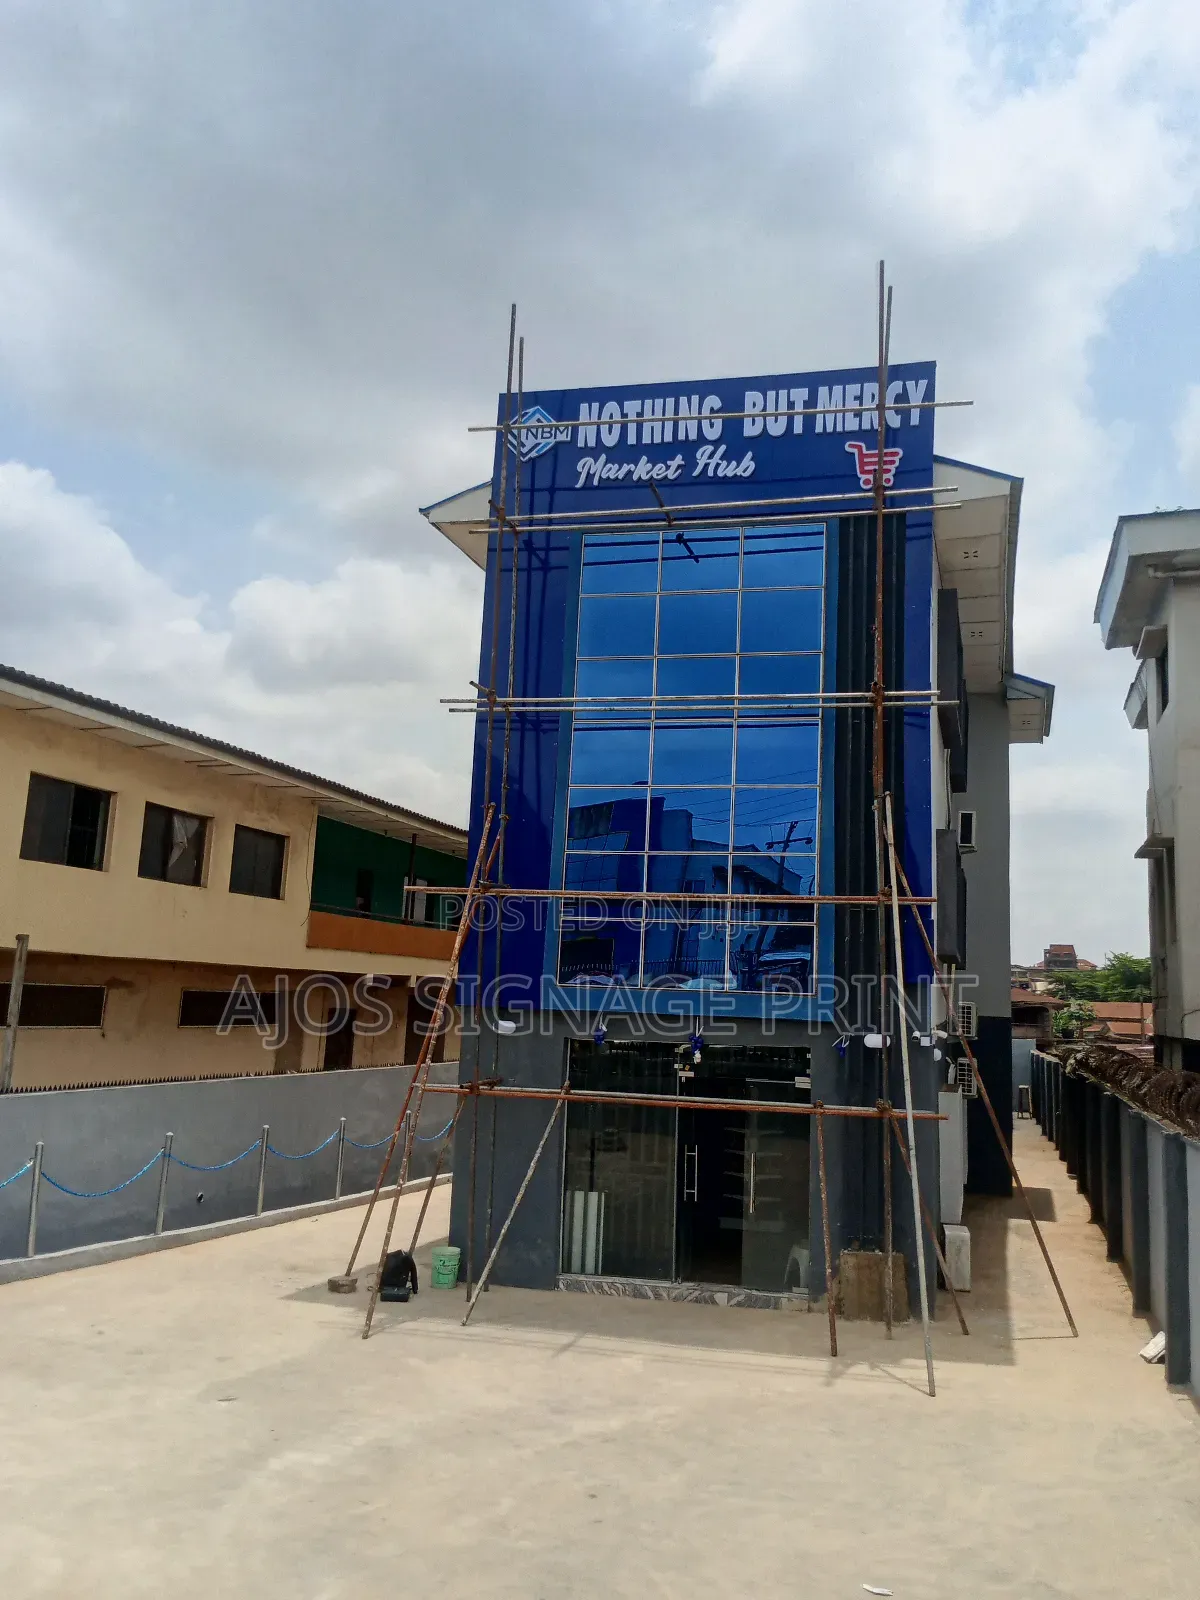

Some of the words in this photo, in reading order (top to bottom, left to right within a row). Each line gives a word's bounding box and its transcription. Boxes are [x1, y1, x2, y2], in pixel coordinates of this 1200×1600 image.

[525, 426, 570, 440] NBM
[577, 395, 723, 448] NOTHING
[743, 387, 809, 437] BUT
[815, 379, 928, 434] MERCY
[575, 453, 685, 488] Market
[692, 444, 756, 479] Hub
